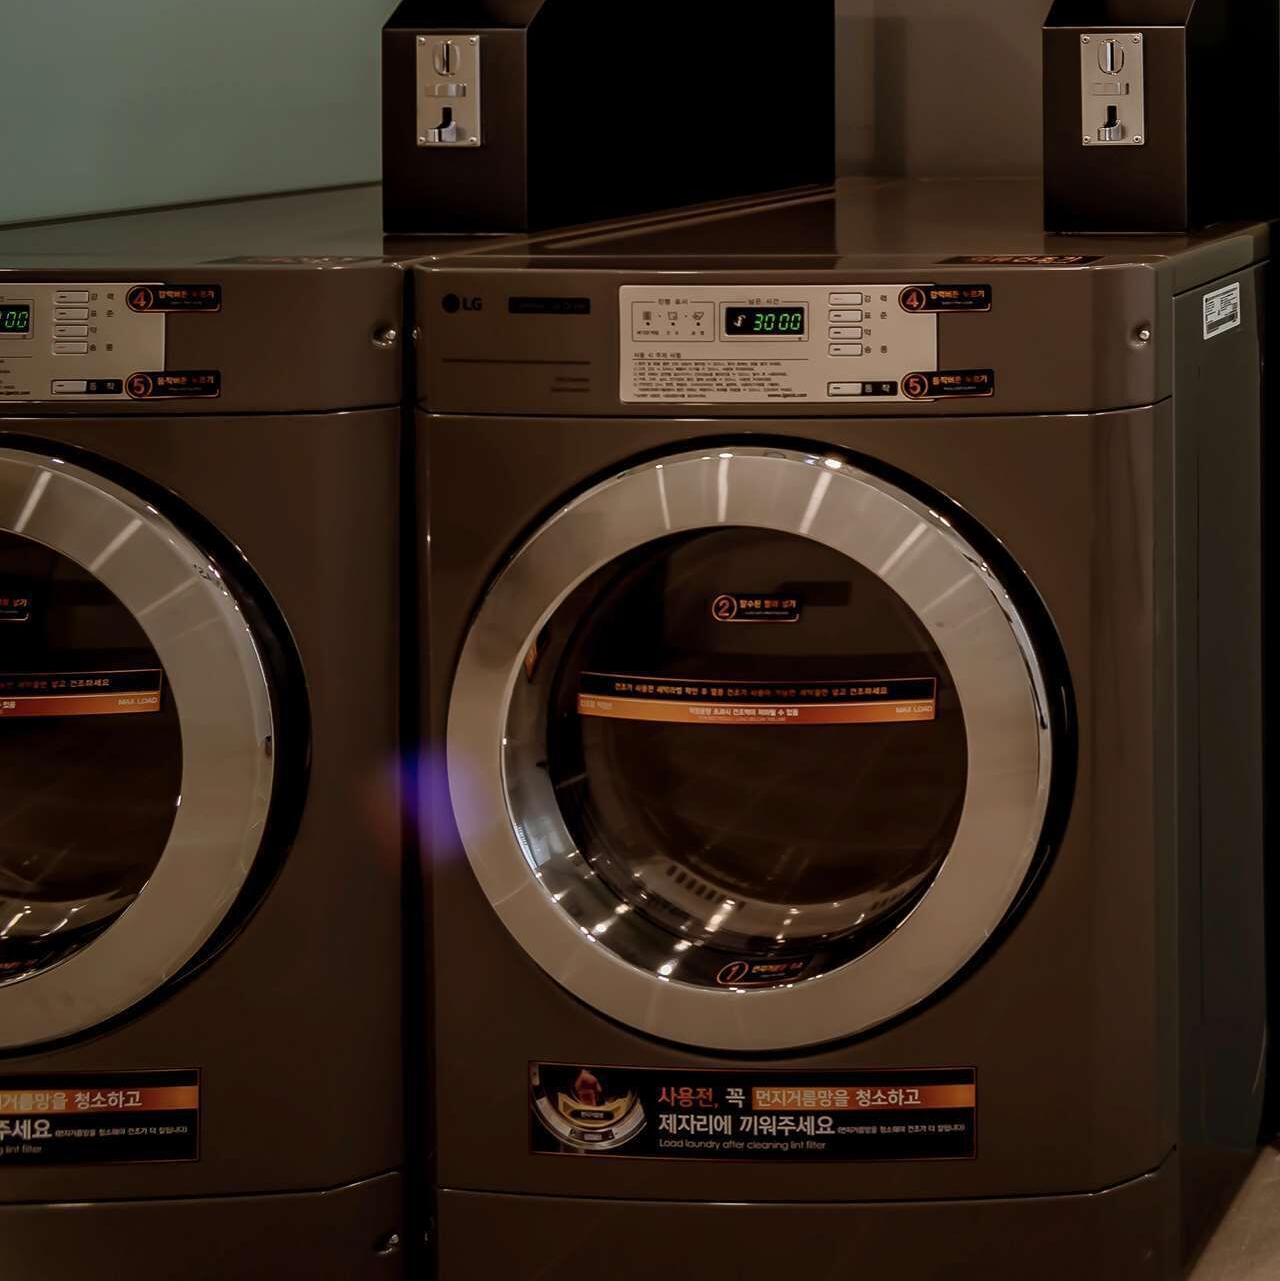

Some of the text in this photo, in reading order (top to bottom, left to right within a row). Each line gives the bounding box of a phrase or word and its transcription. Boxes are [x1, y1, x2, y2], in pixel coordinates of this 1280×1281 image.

[133, 289, 147, 306] 4
[462, 297, 483, 312] LG
[906, 288, 919, 308] 4
[132, 377, 146, 394] 5
[908, 378, 921, 394] 5
[718, 599, 730, 616] 2
[658, 1087, 746, 1111] 사용전, 꼭
[756, 1089, 920, 1109] 먼지거름망을 청소하고
[659, 1114, 836, 1136] 제자리에 끼워주세요
[659, 1138, 827, 1152] Load laundry after cleaning lint filter
